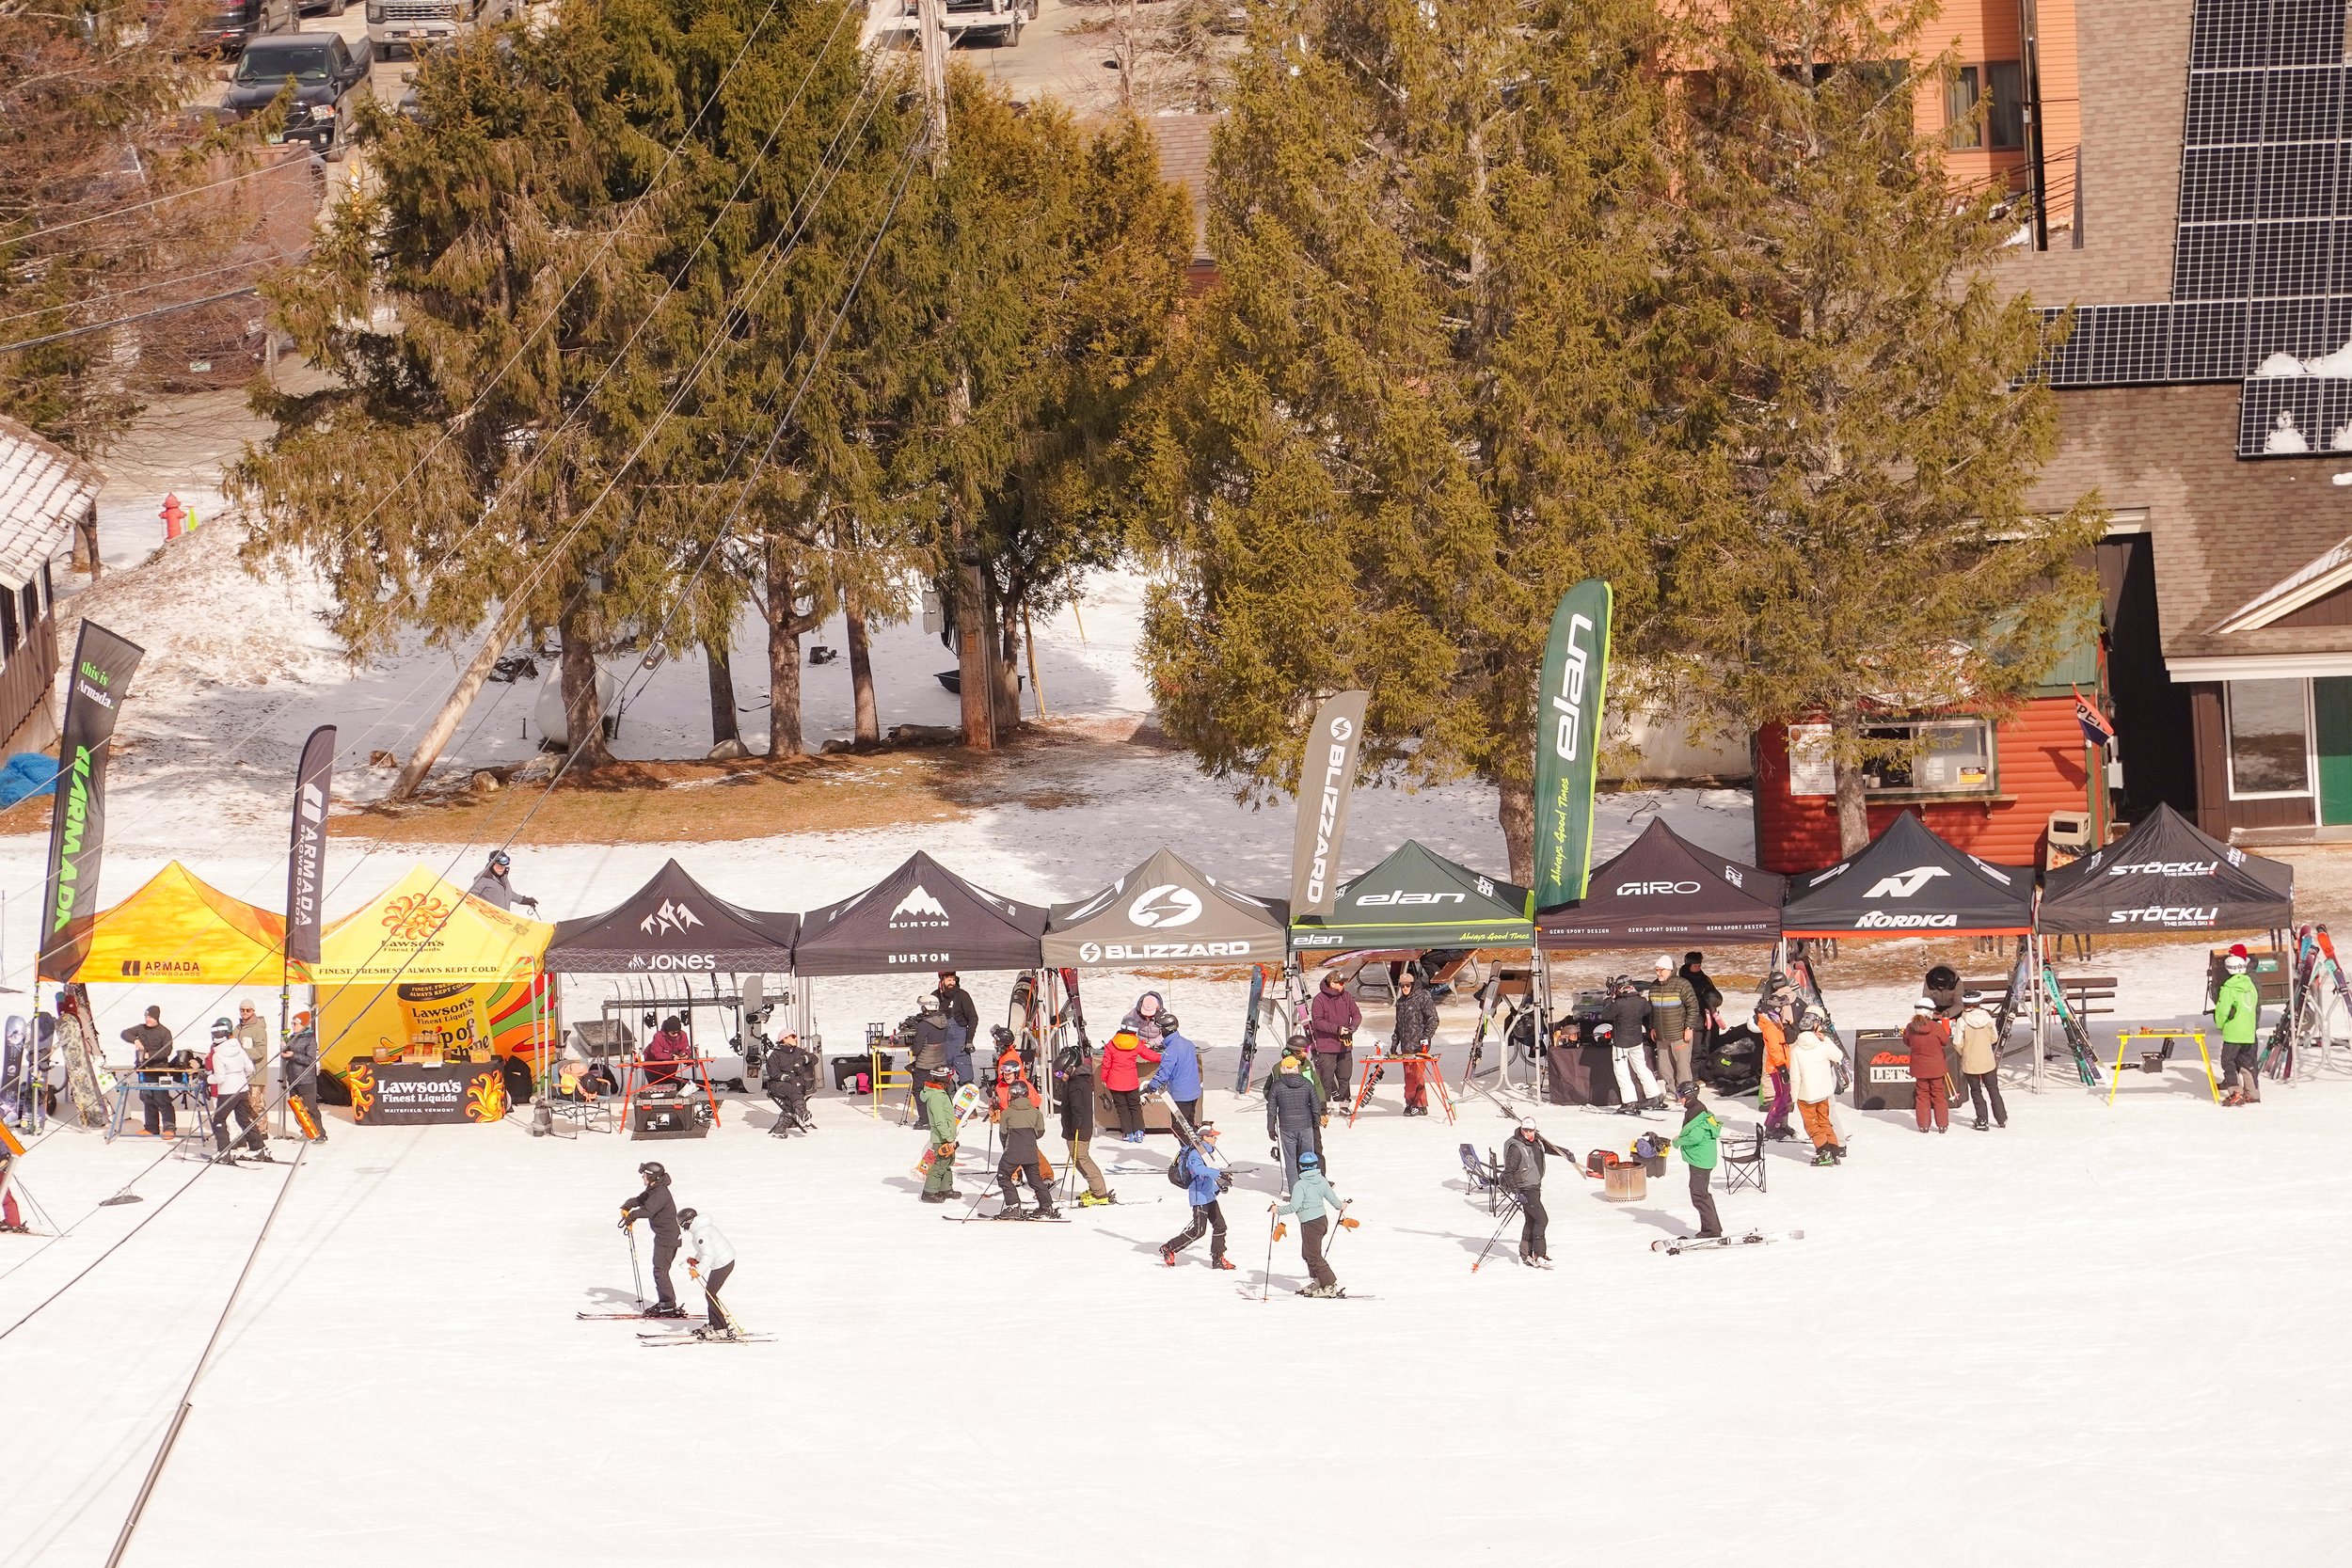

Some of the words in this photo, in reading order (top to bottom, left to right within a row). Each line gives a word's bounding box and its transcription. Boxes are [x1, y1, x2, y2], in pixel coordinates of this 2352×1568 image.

[81, 661, 99, 681] this
[99, 671, 109, 686] is
[1552, 613, 1593, 762] elan
[1307, 746, 1345, 904] BLIZZARD
[1553, 809, 1567, 844] Good
[54, 776, 87, 933] ARMADA
[1550, 846, 1567, 887] Always
[2108, 861, 2218, 876] STÖCKLI
[300, 826, 318, 927] ARMADA
[1616, 881, 1701, 896] GIRO
[1356, 890, 1466, 906] elan
[1854, 911, 1958, 928] NORDICA
[2108, 906, 2218, 924] STÖCKLI
[1293, 934, 1343, 945] elan
[1459, 932, 1486, 942] Always
[1486, 931, 1509, 941] Good
[888, 953, 949, 963] BURTON
[1104, 941, 1250, 959] BLIZZARD
[145, 961, 199, 971] ARMADA
[435, 988, 452, 996] KEPT
[412, 997, 474, 1018] Lawson's
[444, 1008, 473, 1022] Liquids
[456, 1018, 474, 1041] of
[377, 1079, 463, 1094] Lawson's
[382, 1094, 416, 1102] Finest
[418, 1094, 457, 1103] Liquids
